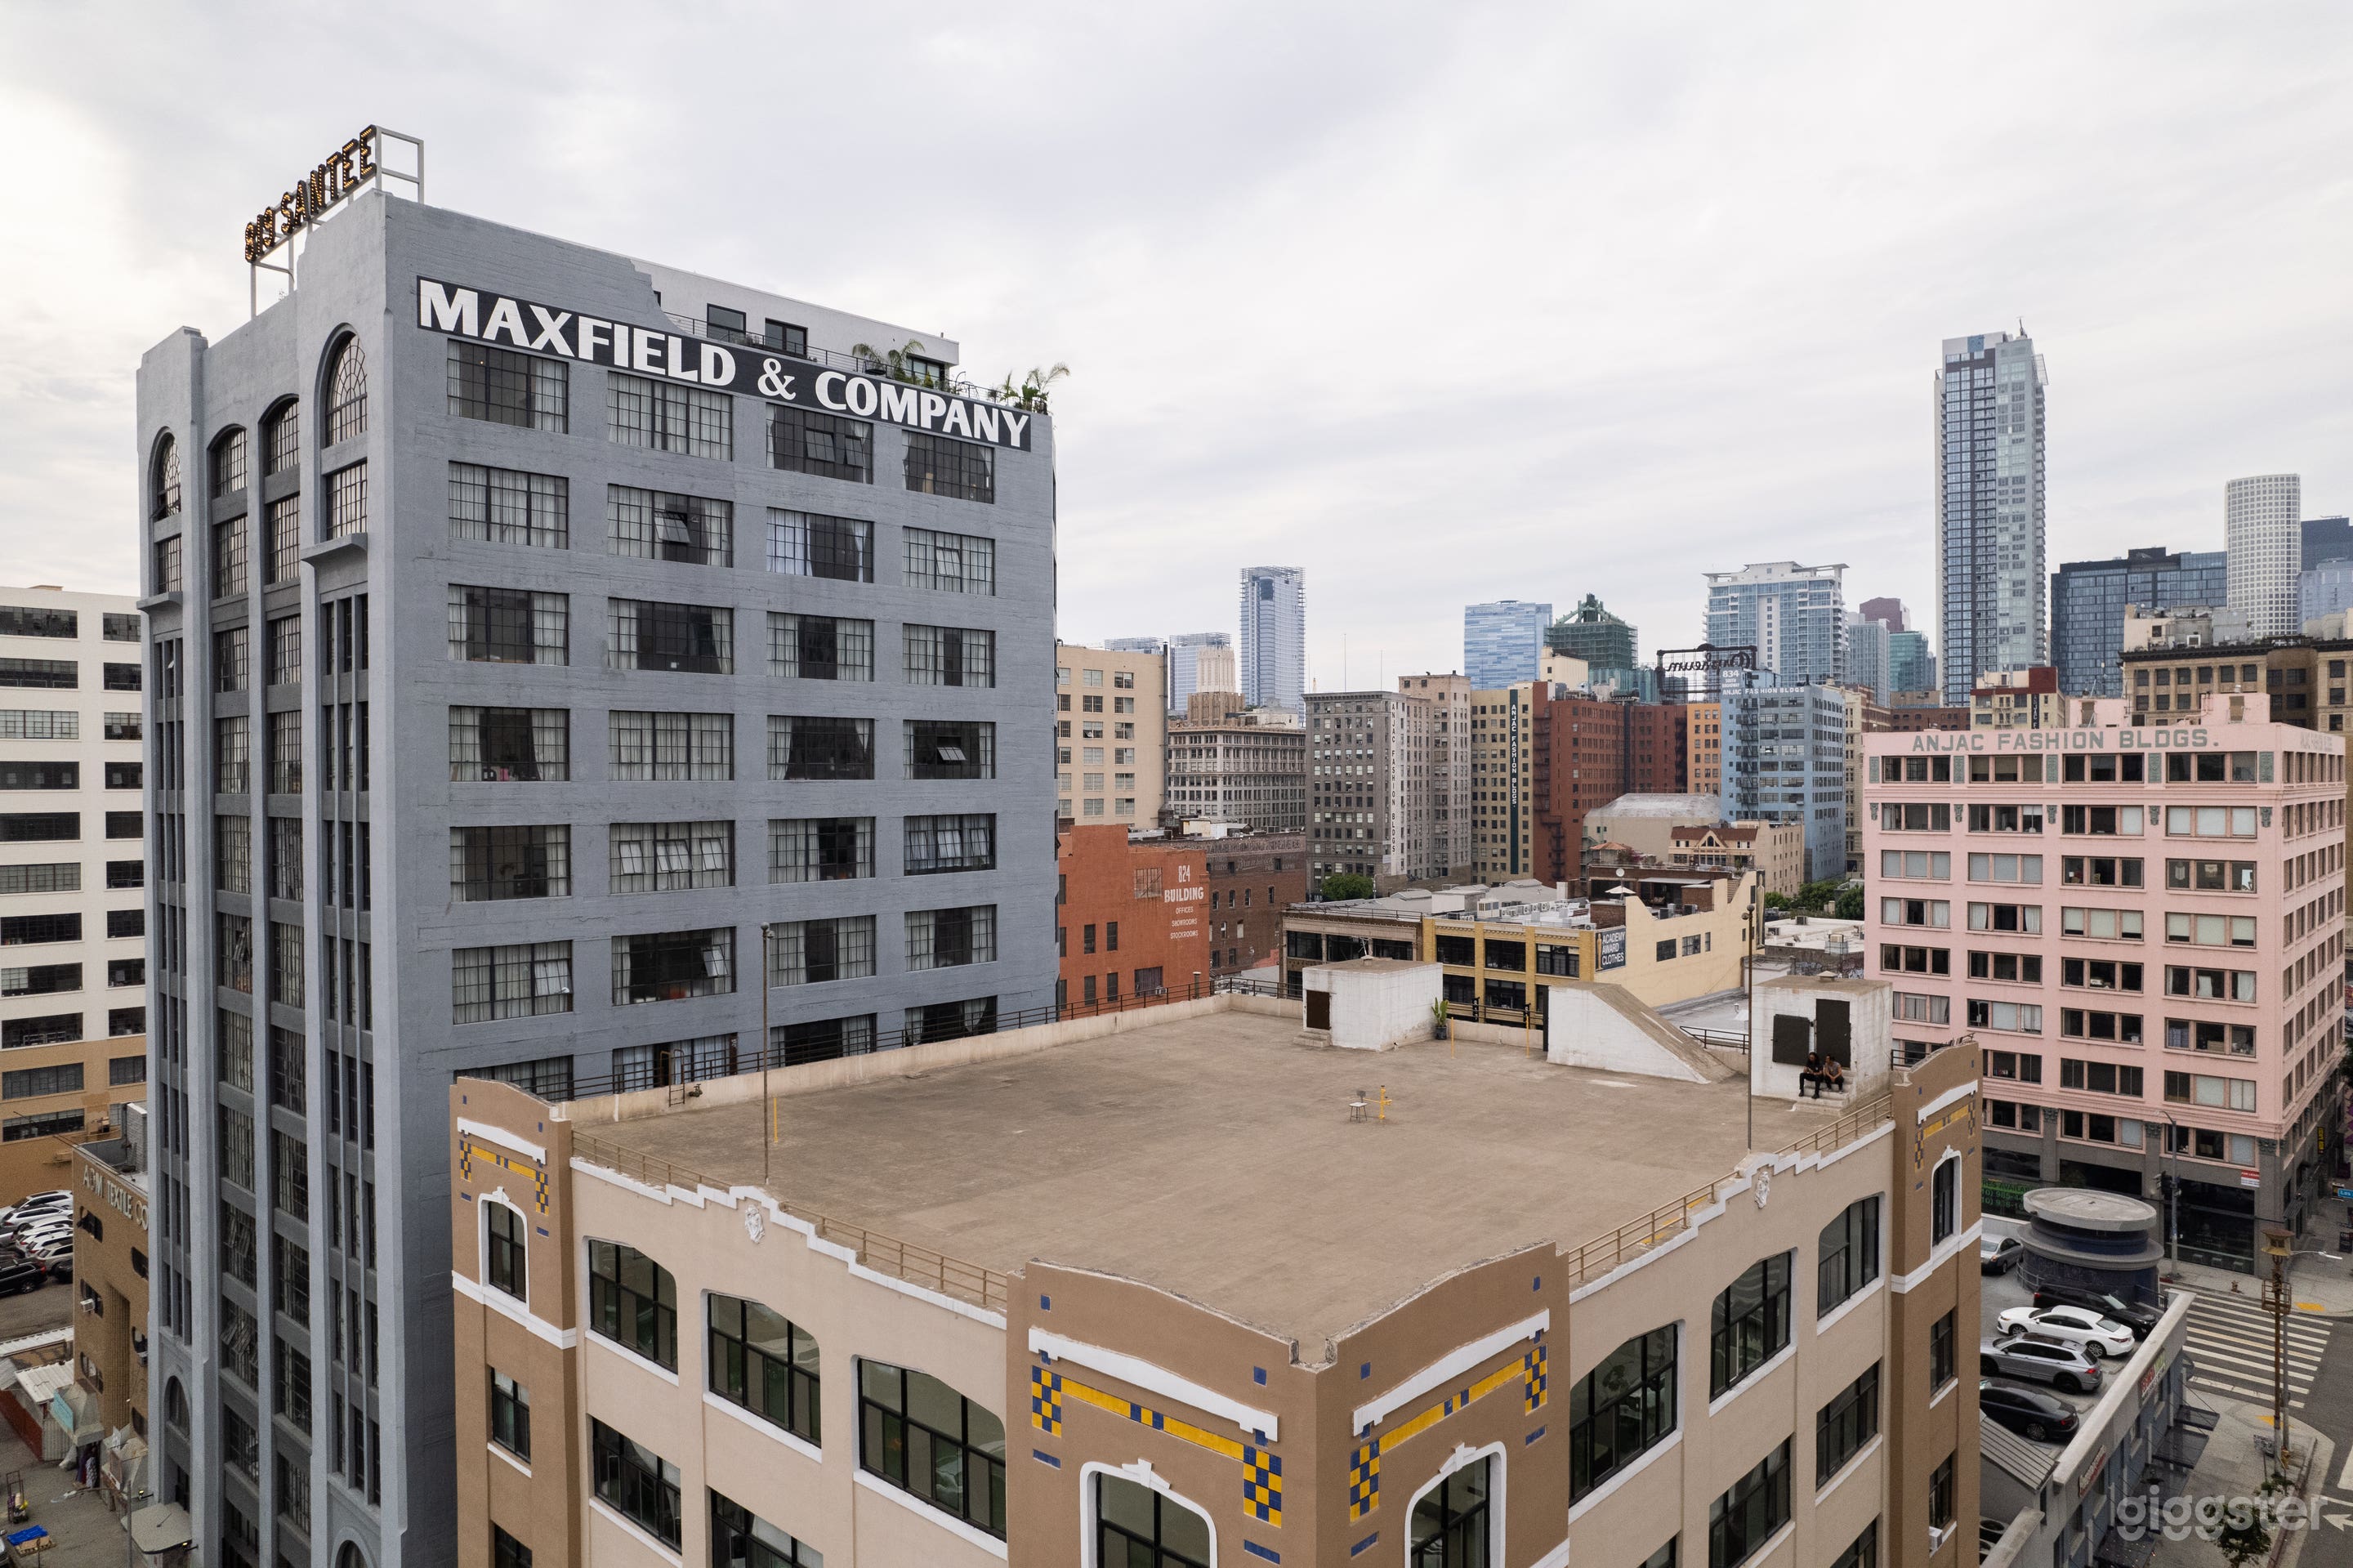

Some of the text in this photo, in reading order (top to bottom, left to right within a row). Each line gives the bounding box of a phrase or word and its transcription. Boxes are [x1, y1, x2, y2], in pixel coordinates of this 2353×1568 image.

[245, 124, 377, 263] 819 SANTEE
[419, 279, 1029, 448] MAXFIELD & COMPANY
[1912, 729, 2219, 752] ANJAC FASHION BLDGS.
[1178, 864, 1190, 882] 824
[1164, 887, 1204, 903] BUILDING
[1175, 906, 1194, 914] OFFICES
[1171, 918, 1197, 927] SHOWROOMS
[1170, 930, 1199, 940] STOCKROOMS
[1602, 931, 1626, 945] ACADEMY
[1602, 942, 1619, 954] AWARD
[1602, 952, 1624, 965] CLOTHES
[107, 1180, 132, 1219] TEXTILE
